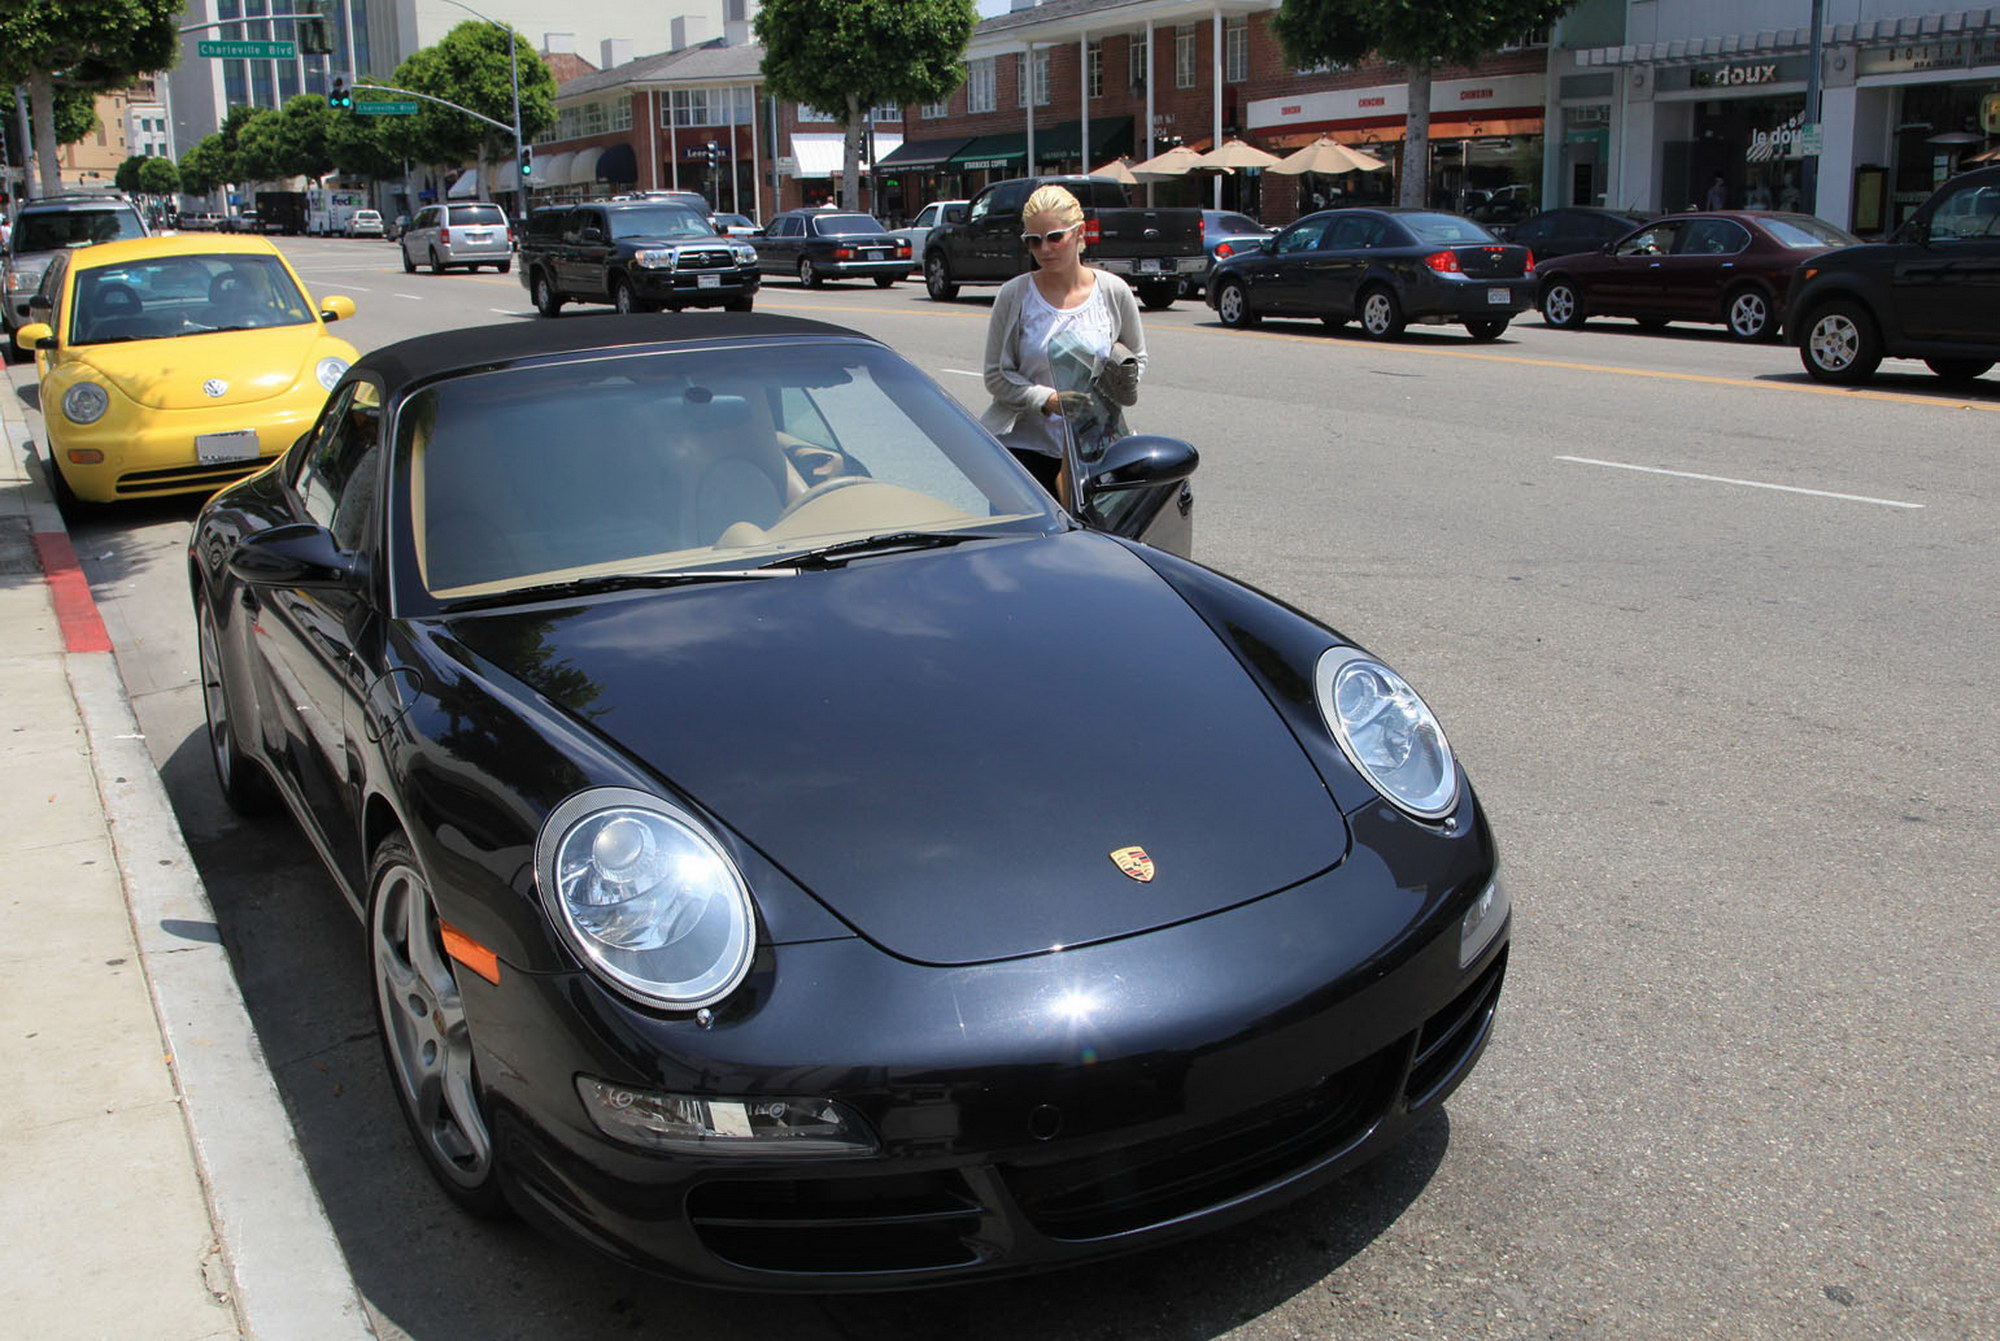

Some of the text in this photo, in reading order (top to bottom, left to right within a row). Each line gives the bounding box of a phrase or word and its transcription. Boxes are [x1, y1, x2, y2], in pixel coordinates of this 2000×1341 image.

[200, 44, 292, 54] Charleville Blvd
[1715, 64, 1776, 85] doux
[1771, 126, 1803, 144] dou
[332, 195, 361, 206] FedEx
